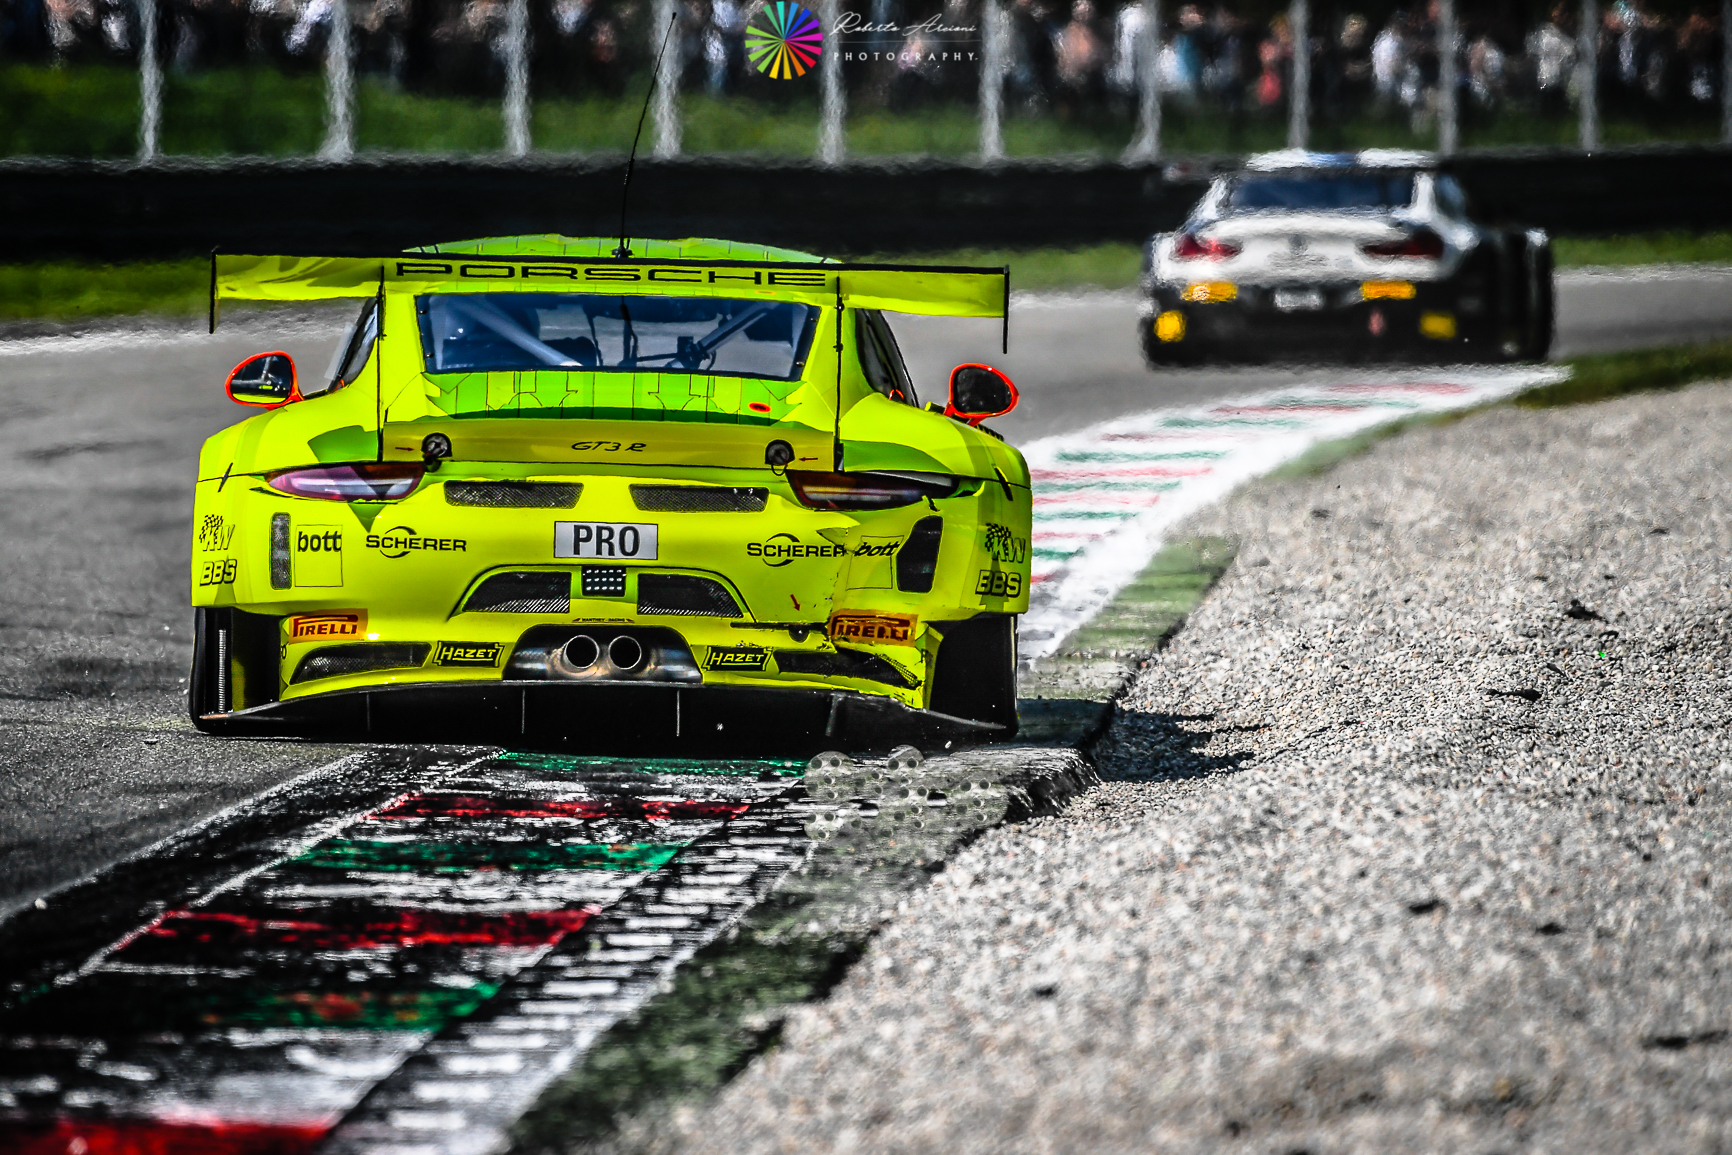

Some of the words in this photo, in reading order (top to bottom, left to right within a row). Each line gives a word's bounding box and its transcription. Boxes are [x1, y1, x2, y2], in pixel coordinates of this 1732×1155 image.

[396, 262, 826, 287] PORSCHE
[571, 441, 621, 452] GT3
[625, 442, 647, 452] R
[297, 531, 342, 553] bott
[366, 534, 467, 552] SCHERER
[573, 524, 640, 557] PRO
[854, 541, 901, 557] bott
[199, 559, 238, 587] BBS
[975, 570, 1022, 598] BBS
[293, 614, 358, 638] PIRELLI
[440, 646, 497, 661] HAZET
[709, 652, 765, 665] HAZET
